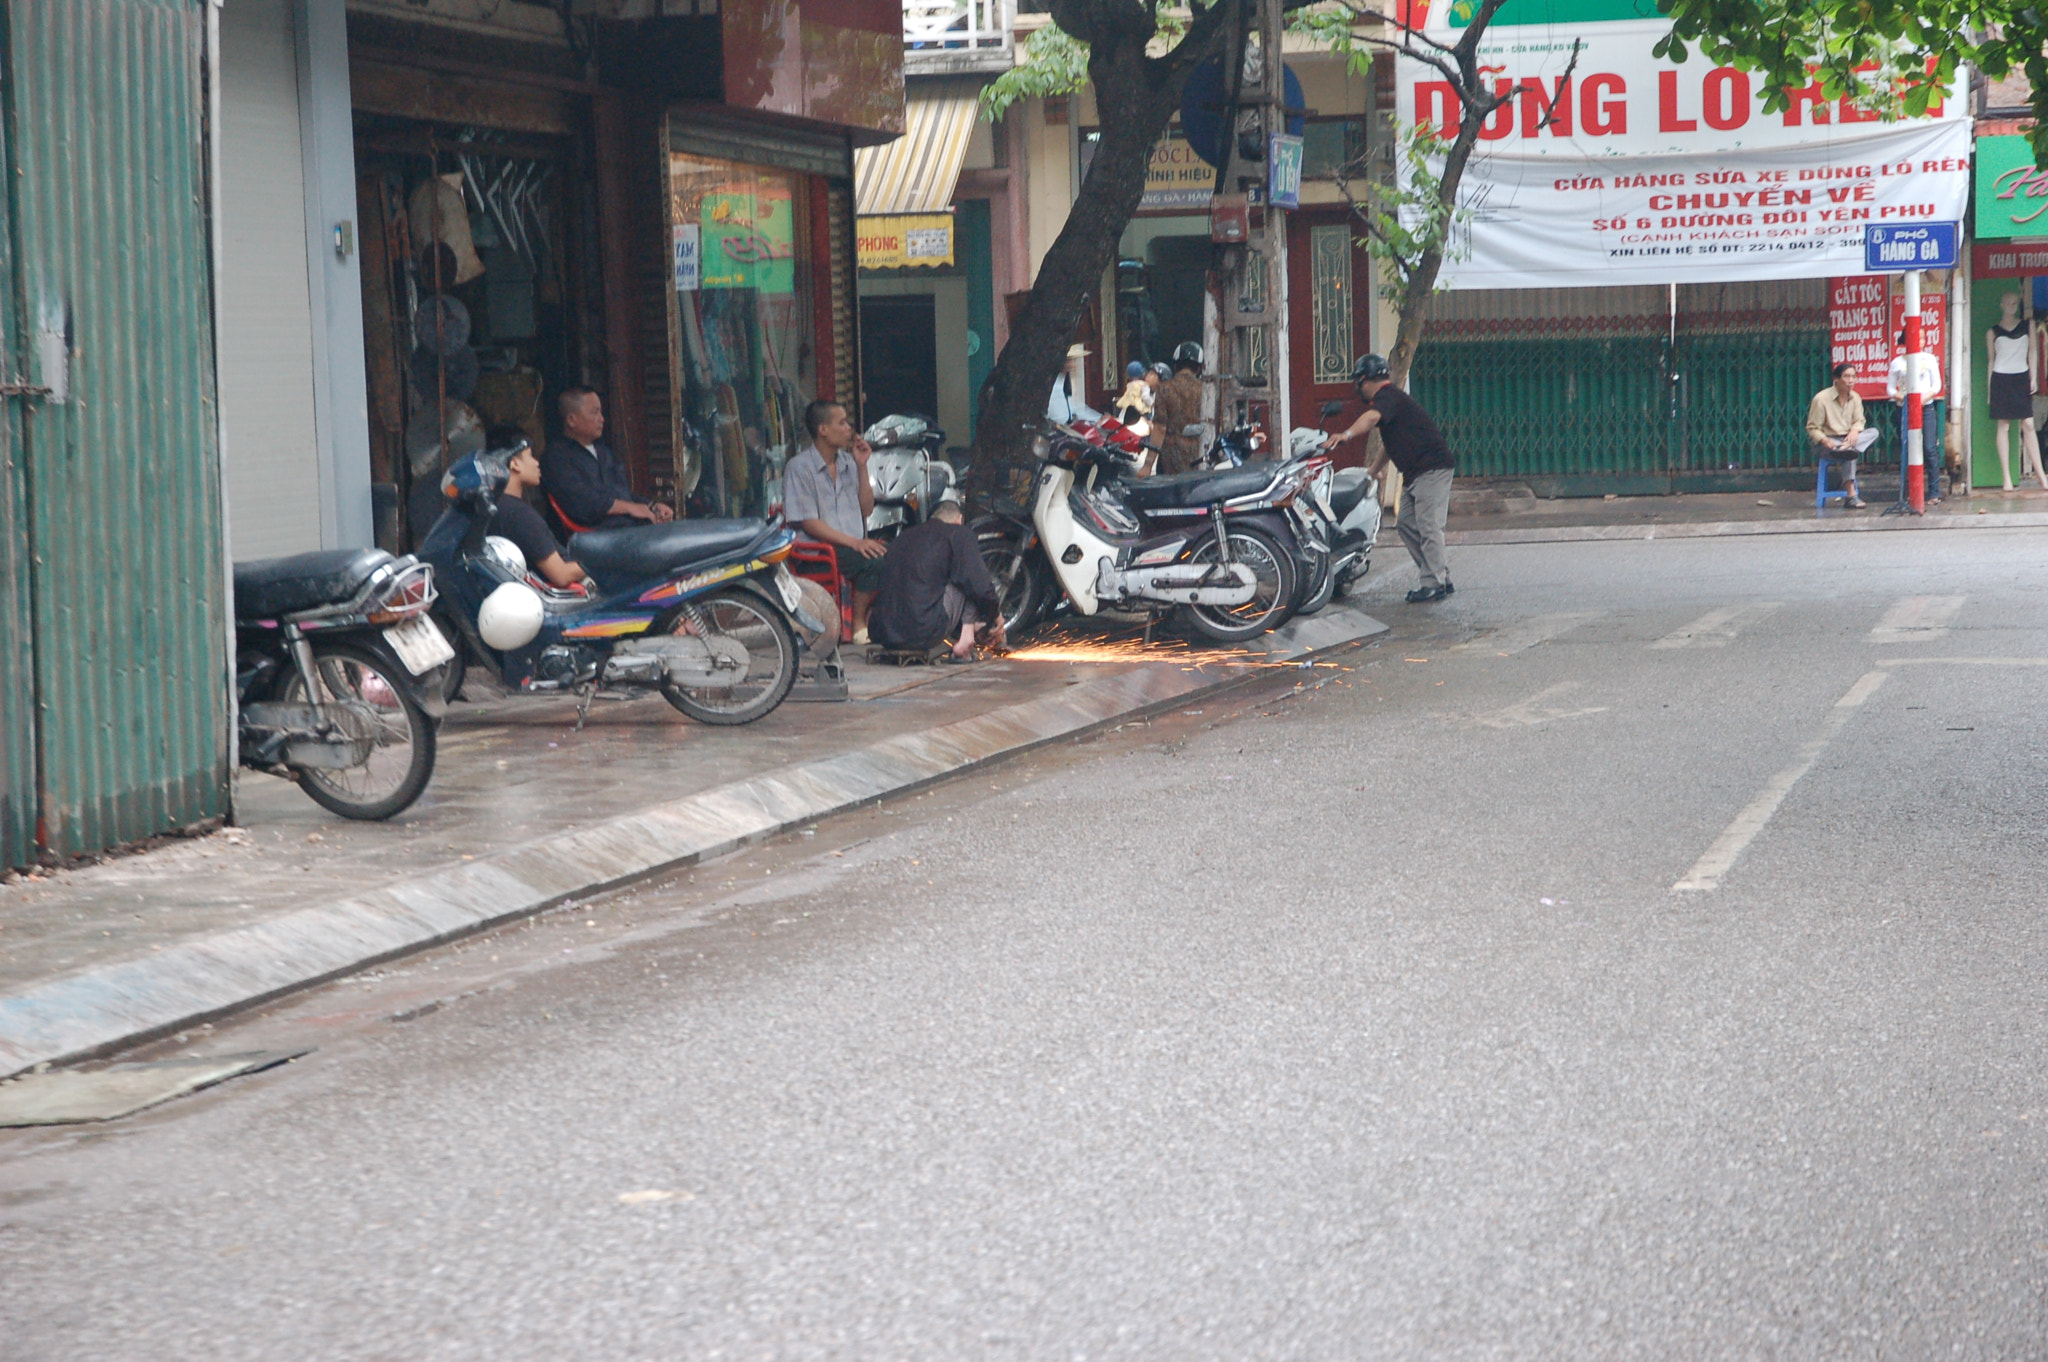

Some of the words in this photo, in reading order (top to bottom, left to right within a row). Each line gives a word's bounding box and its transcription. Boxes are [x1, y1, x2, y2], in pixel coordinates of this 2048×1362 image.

[1179, 167, 1212, 182] HIỆU
[1554, 172, 1605, 192] CỬA
[1614, 171, 1685, 189] HÀNG
[1695, 167, 1747, 185] SỬA
[1756, 170, 1789, 183] XE
[1799, 164, 1872, 181] DŨNG
[1649, 183, 1811, 211] CHUYỂN
[1827, 178, 1875, 203] VỀ
[1592, 213, 1628, 231] SỐ
[1636, 217, 1652, 229] 6
[1661, 212, 1753, 229] ĐƯỜNG
[1818, 206, 1869, 222] YÊN
[1880, 203, 1935, 219] PHỤ
[1620, 232, 1682, 245] (CẠNH
[1689, 227, 1759, 241] KHÁCH
[1766, 227, 1807, 240] SẠN
[1814, 223, 1865, 235] SOFI
[1894, 227, 1928, 240] PHỐ
[1609, 248, 1634, 257] XIN
[1638, 245, 1670, 257] LIÊN
[1675, 245, 1694, 256] HỆ
[1880, 239, 1916, 262] HÀNG
[1920, 238, 1940, 261] GÀ
[1835, 277, 1857, 305] CẮT
[1859, 278, 1882, 303] TÓC
[1830, 307, 1869, 329] TRANG
[1920, 307, 1939, 327] TÓC
[1868, 338, 1889, 360] BẮC
[1157, 508, 1184, 516] HONDA
